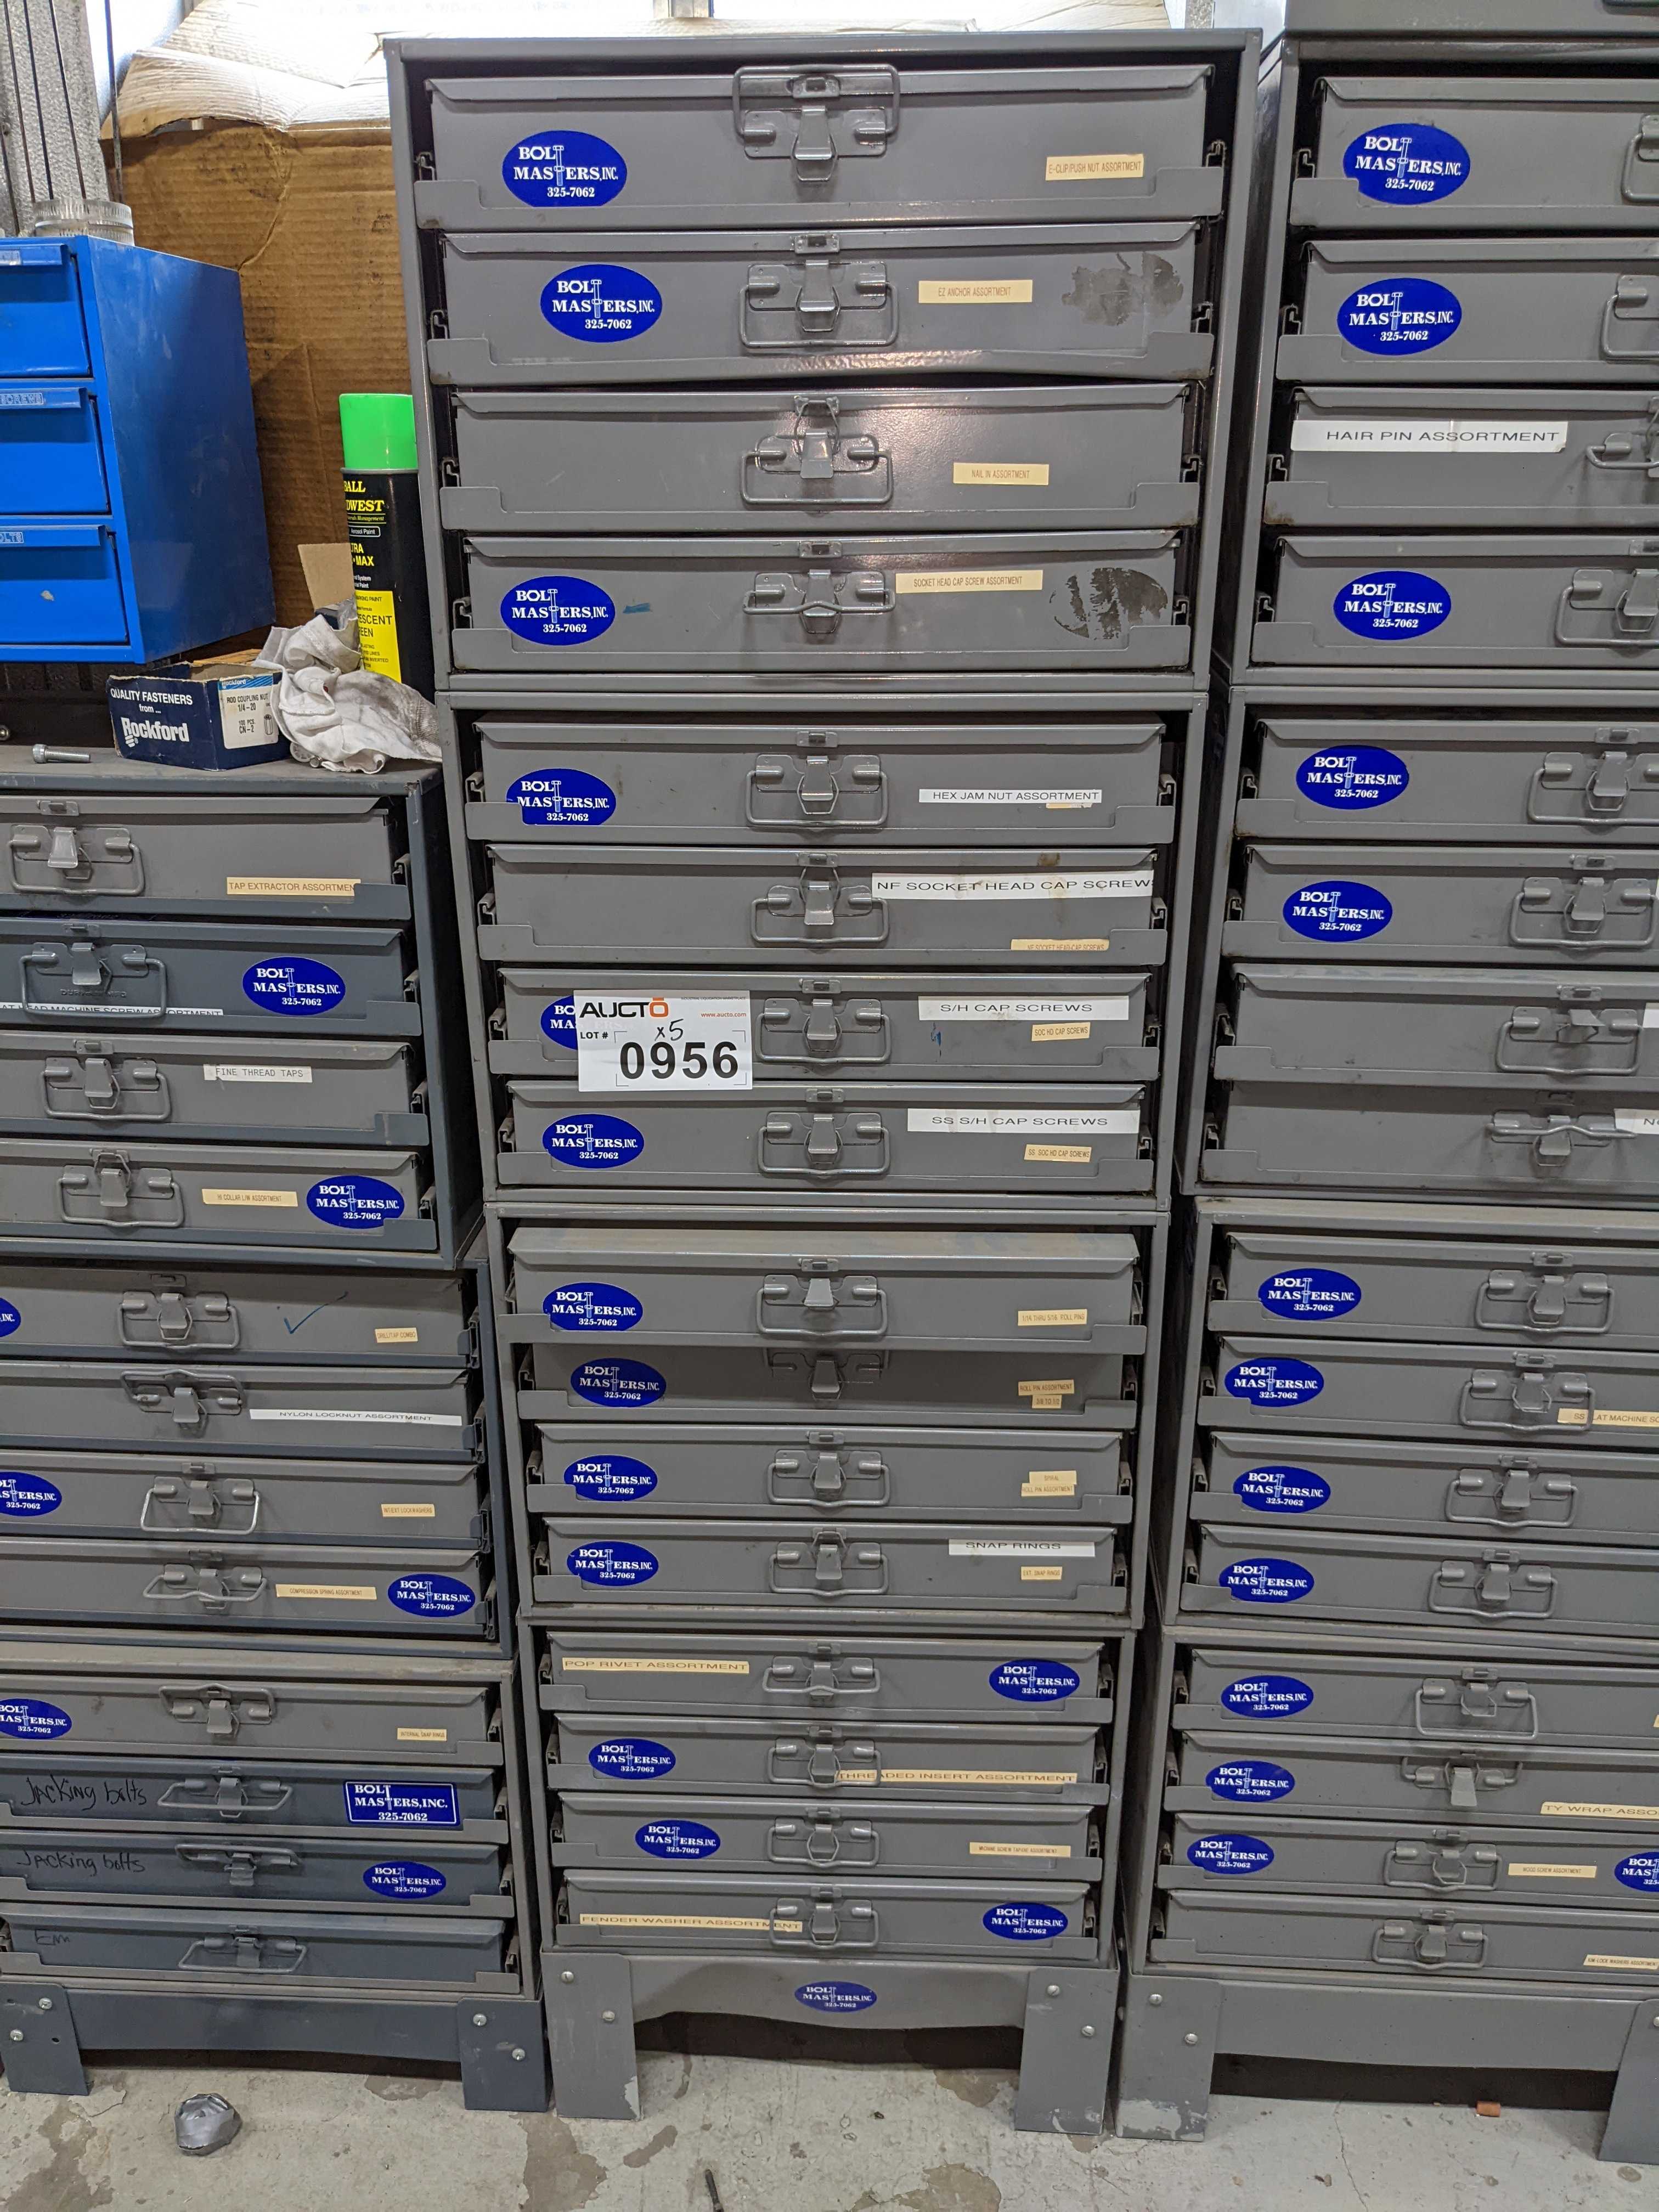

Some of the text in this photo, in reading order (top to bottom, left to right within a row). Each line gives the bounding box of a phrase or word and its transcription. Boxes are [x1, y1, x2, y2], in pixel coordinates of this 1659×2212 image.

[1049, 161, 1141, 173] E-CLIP/PUSH NUT ASSORTMENT
[1386, 178, 1434, 190] 325-7062
[548, 187, 595, 197] 325-7062
[939, 286, 1011, 297] EZ ANCHOR ASSORTMENT
[1327, 432, 1559, 441] HAIR PIN ASSORTMENT
[972, 470, 984, 478] NAIL
[992, 470, 1030, 478] ASSORTMENT
[914, 578, 935, 588] SOCKET
[953, 578, 963, 586] CAP
[965, 577, 984, 585] SCREW
[986, 577, 1022, 585] ASSORTMENT
[1373, 619, 1418, 628] 325-7062
[543, 624, 586, 633] 325-7062
[110, 688, 193, 705] QUALITY FASTENERS
[139, 704, 154, 713] from
[121, 717, 189, 744] Rockford
[303, 883, 354, 891] ASSORTMEN
[907, 882, 981, 891] SOCKET
[620, 1041, 738, 1080] 0956
[647, 1662, 748, 1671] ASSORTMENT
[379, 1813, 428, 1821] 325-7062
